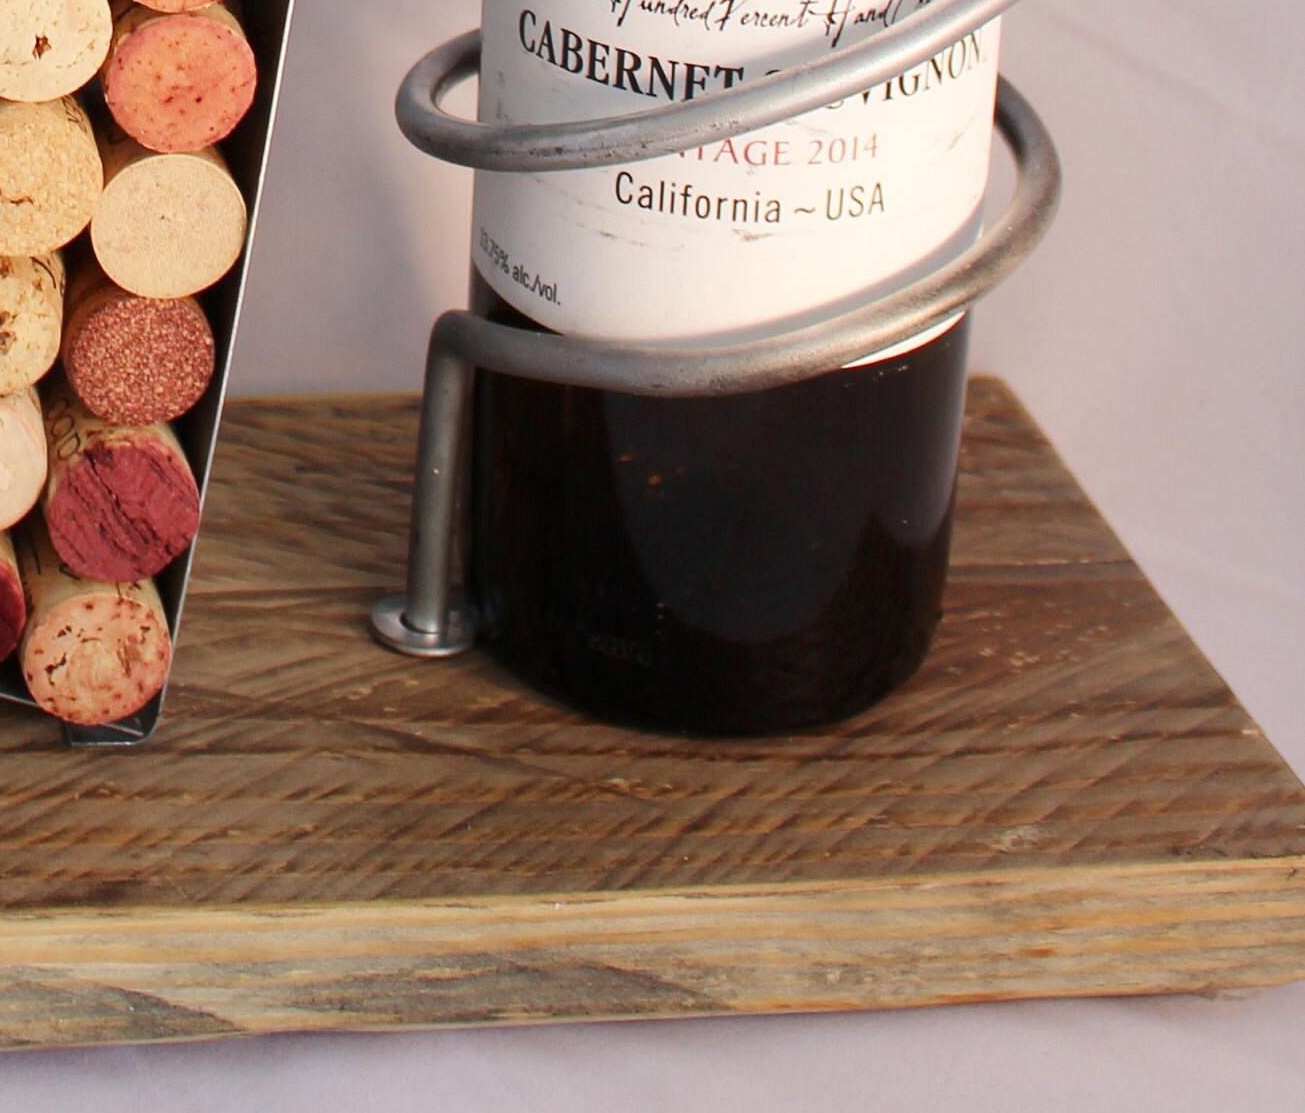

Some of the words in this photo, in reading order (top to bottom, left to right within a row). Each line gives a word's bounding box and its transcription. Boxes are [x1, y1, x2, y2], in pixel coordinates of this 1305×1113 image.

[519, 9, 745, 103] CABERNET
[807, 133, 879, 166] 2014
[614, 171, 782, 224] California
[825, 182, 886, 222] USA
